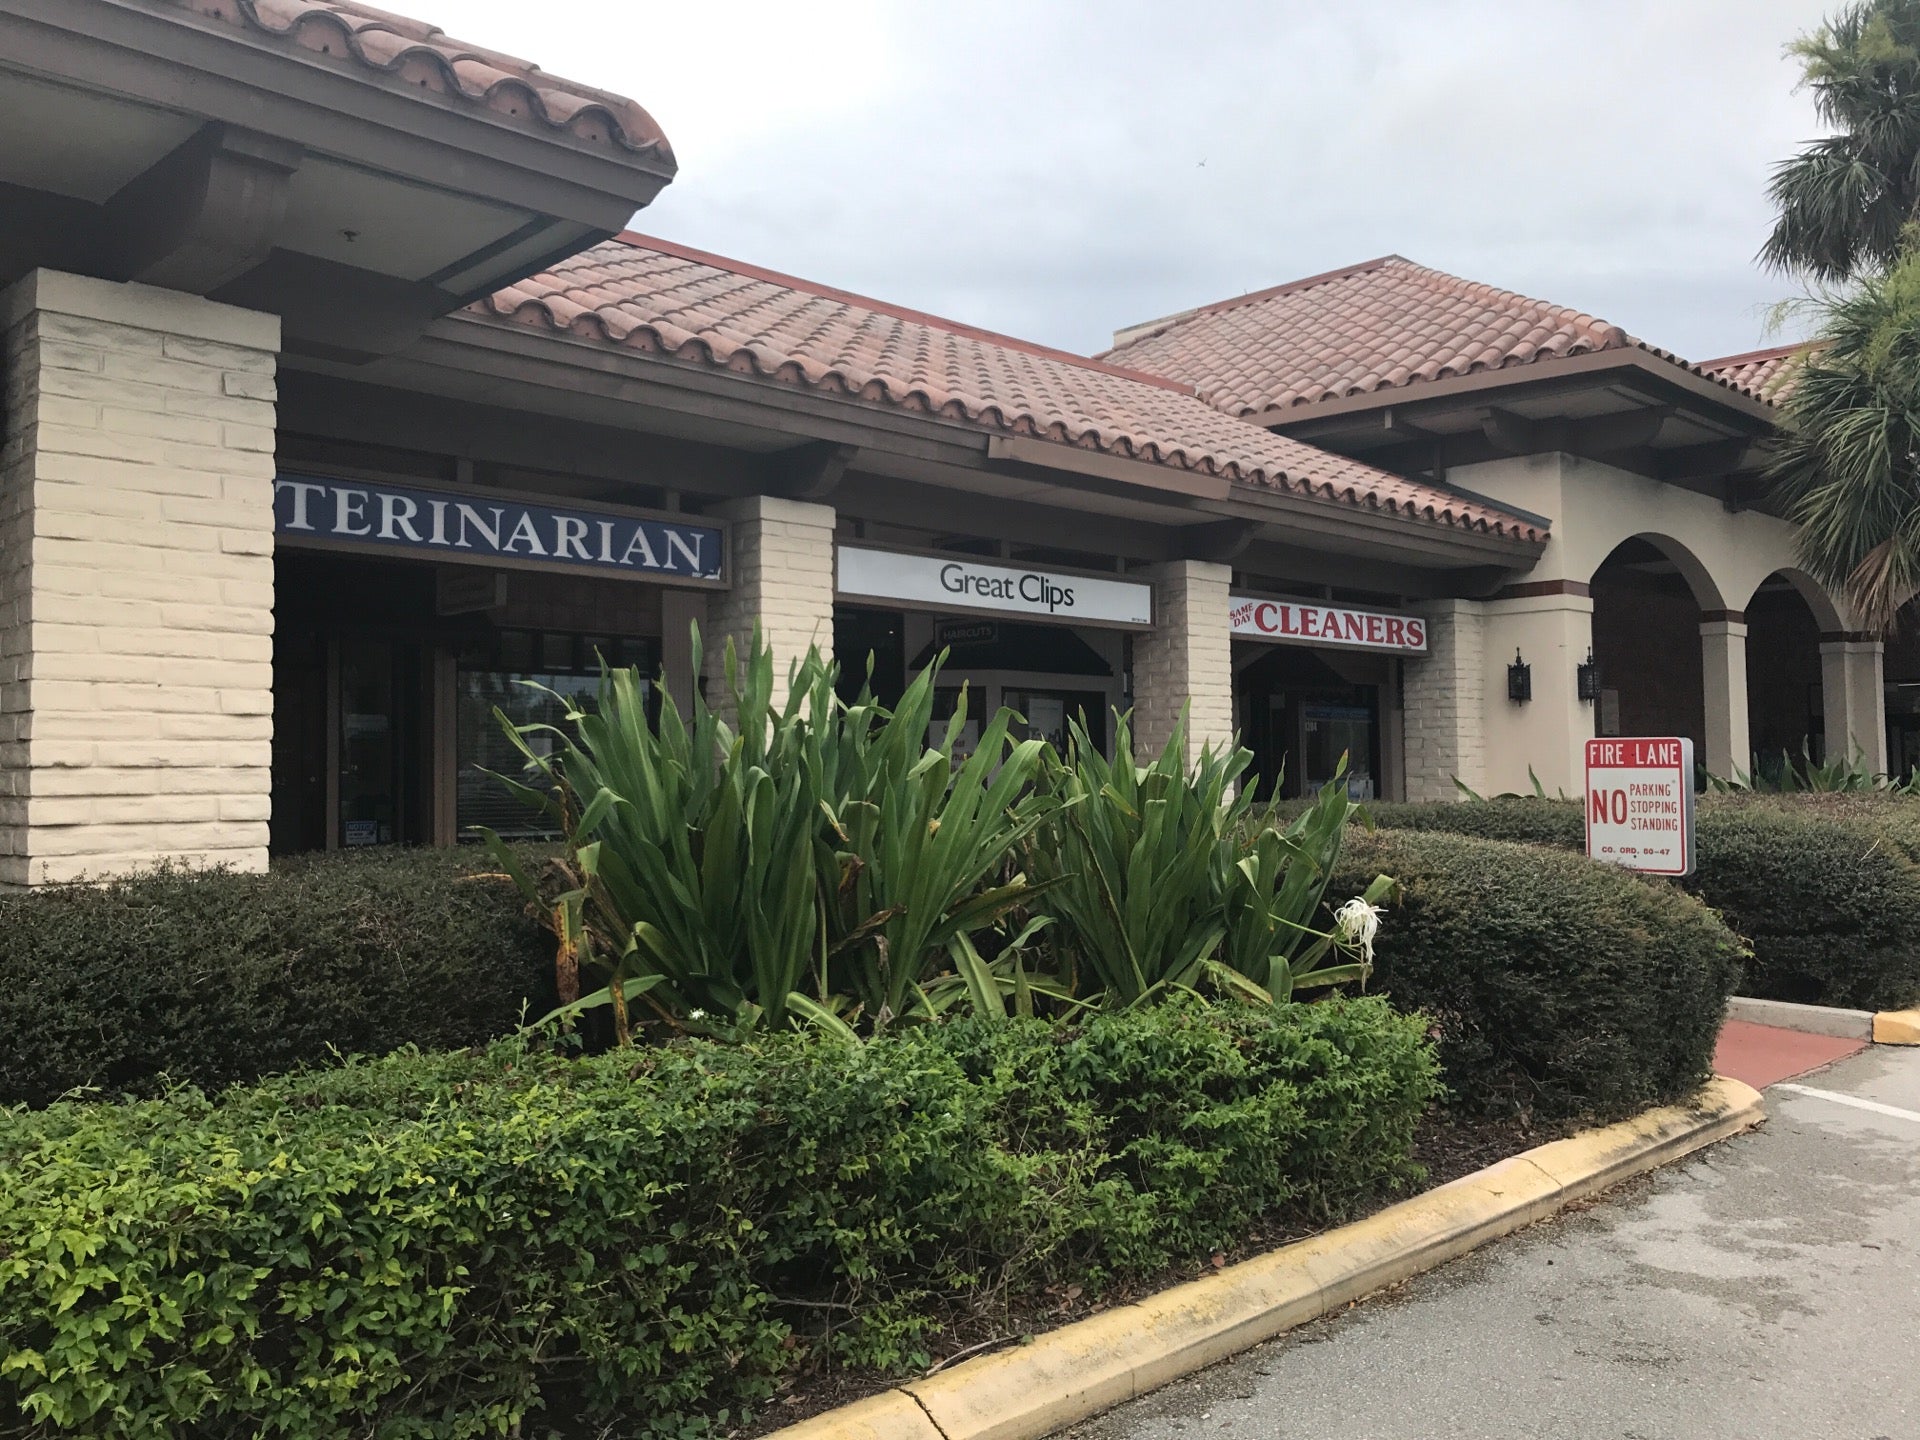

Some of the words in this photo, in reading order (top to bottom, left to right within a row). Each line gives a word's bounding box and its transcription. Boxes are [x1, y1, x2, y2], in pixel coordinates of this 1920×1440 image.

[276, 481, 704, 572] TERINARIAN
[940, 563, 1015, 600] Great
[1019, 574, 1074, 612] Clips
[1230, 602, 1253, 619] SAME
[1234, 614, 1251, 627] DAY
[1254, 603, 1424, 646] CLEANERS
[1590, 744, 1624, 764] FIRE
[1635, 744, 1679, 764] LANE
[1629, 783, 1671, 797] PARKING
[1592, 789, 1628, 824] NO
[1630, 800, 1677, 814] STOPPING
[1630, 817, 1678, 831] STANDING
[1601, 846, 1616, 854] CO.
[1619, 847, 1640, 855] ORD.
